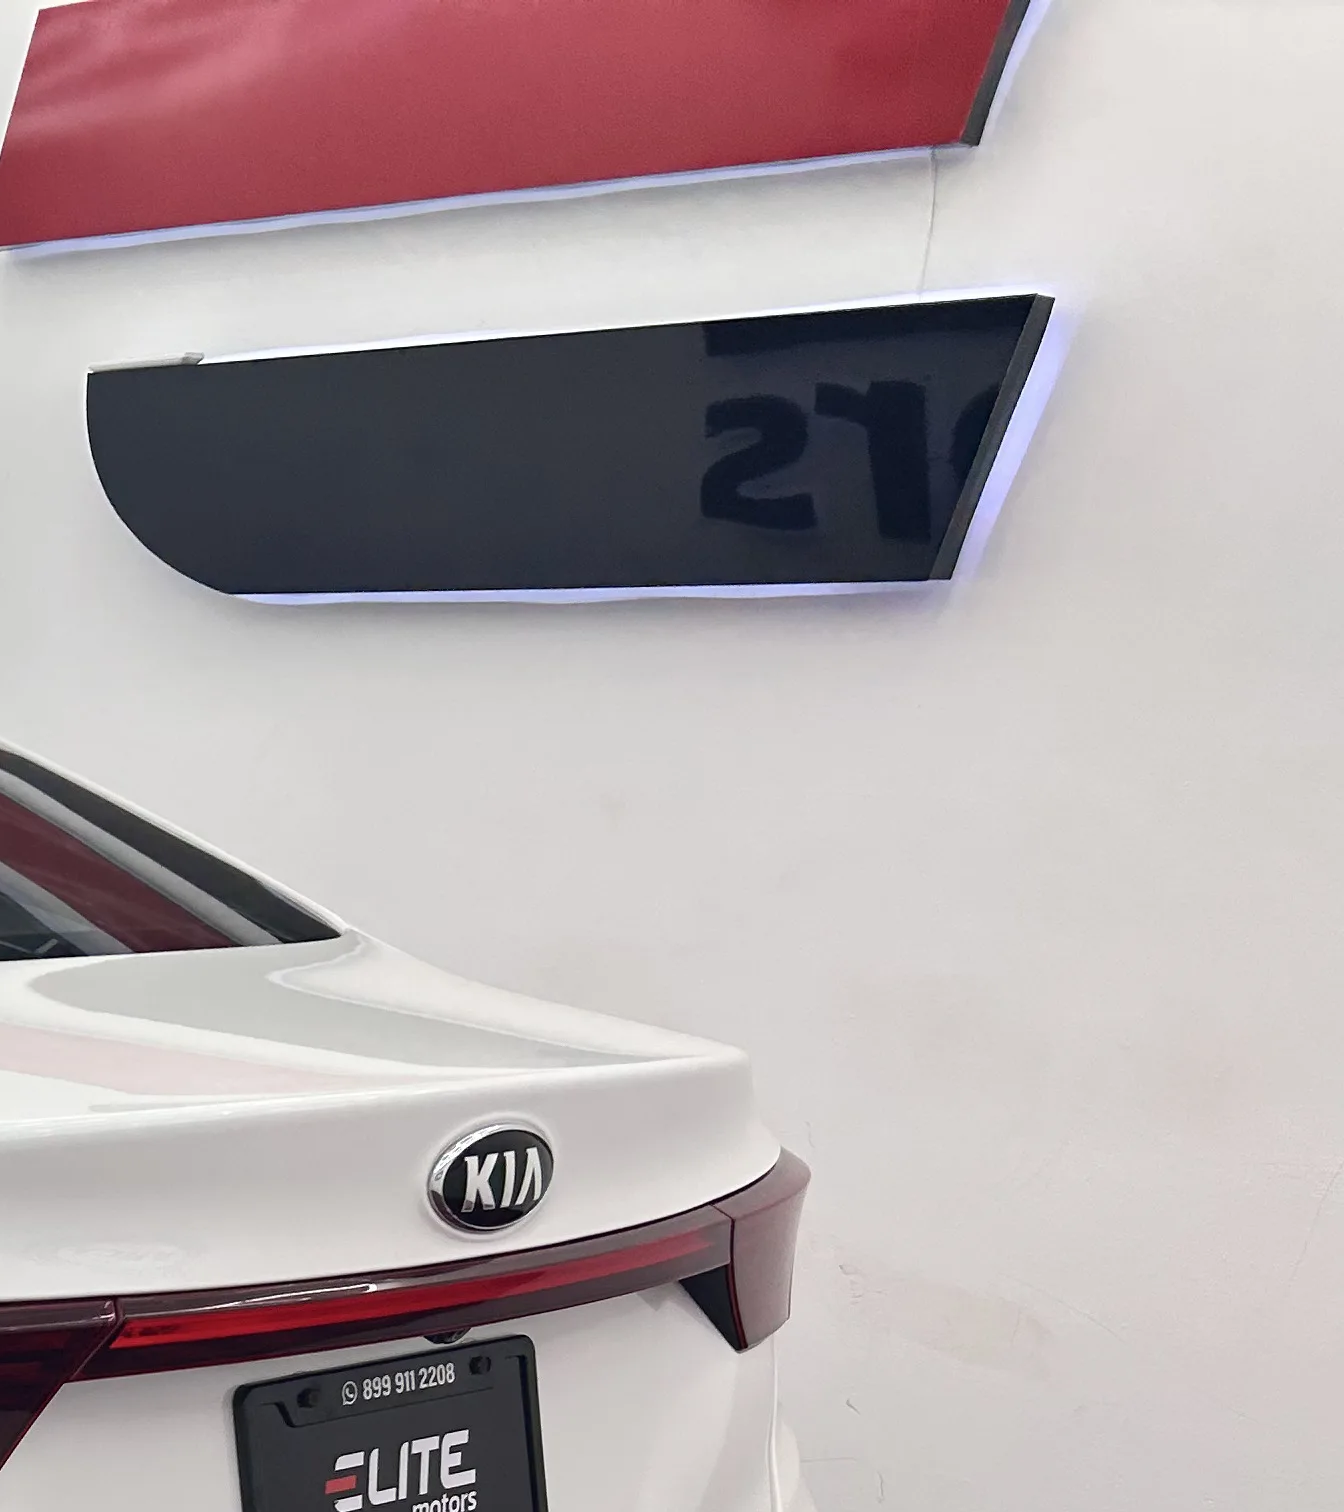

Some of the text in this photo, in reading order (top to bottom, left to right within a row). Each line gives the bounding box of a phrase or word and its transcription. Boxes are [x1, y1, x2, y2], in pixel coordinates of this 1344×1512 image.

[460, 1146, 544, 1213] KIA
[362, 1361, 456, 1401] 899 911 2208
